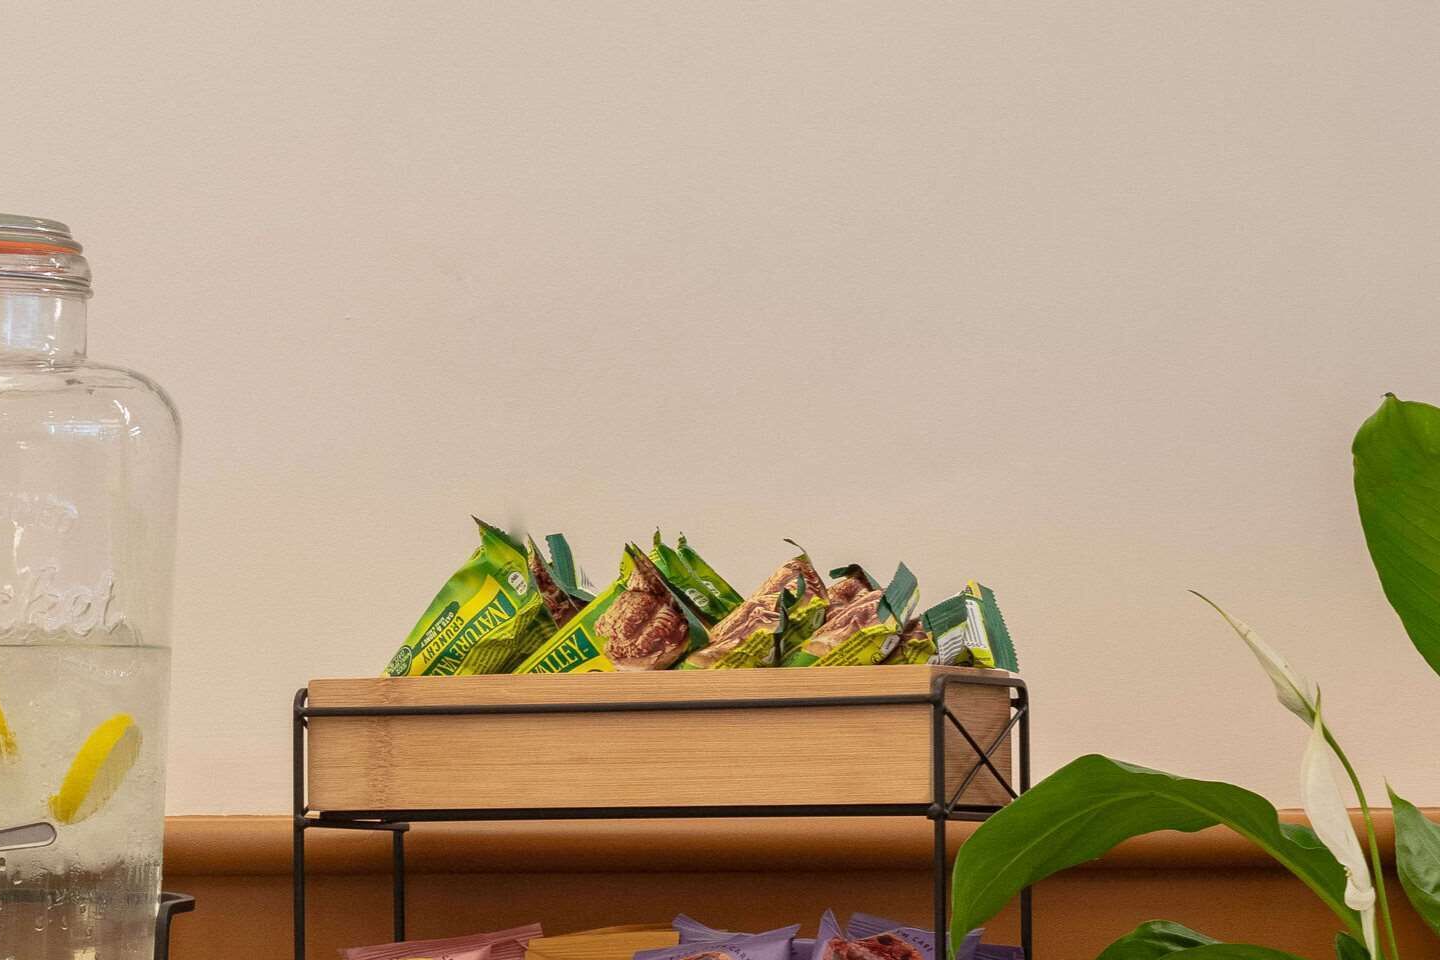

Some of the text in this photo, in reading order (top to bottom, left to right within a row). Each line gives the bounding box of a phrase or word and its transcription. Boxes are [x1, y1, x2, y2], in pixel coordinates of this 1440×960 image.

[422, 615, 465, 664] CRUNCHY
[448, 598, 511, 660] NATURE
[535, 633, 589, 673] ALLEY
